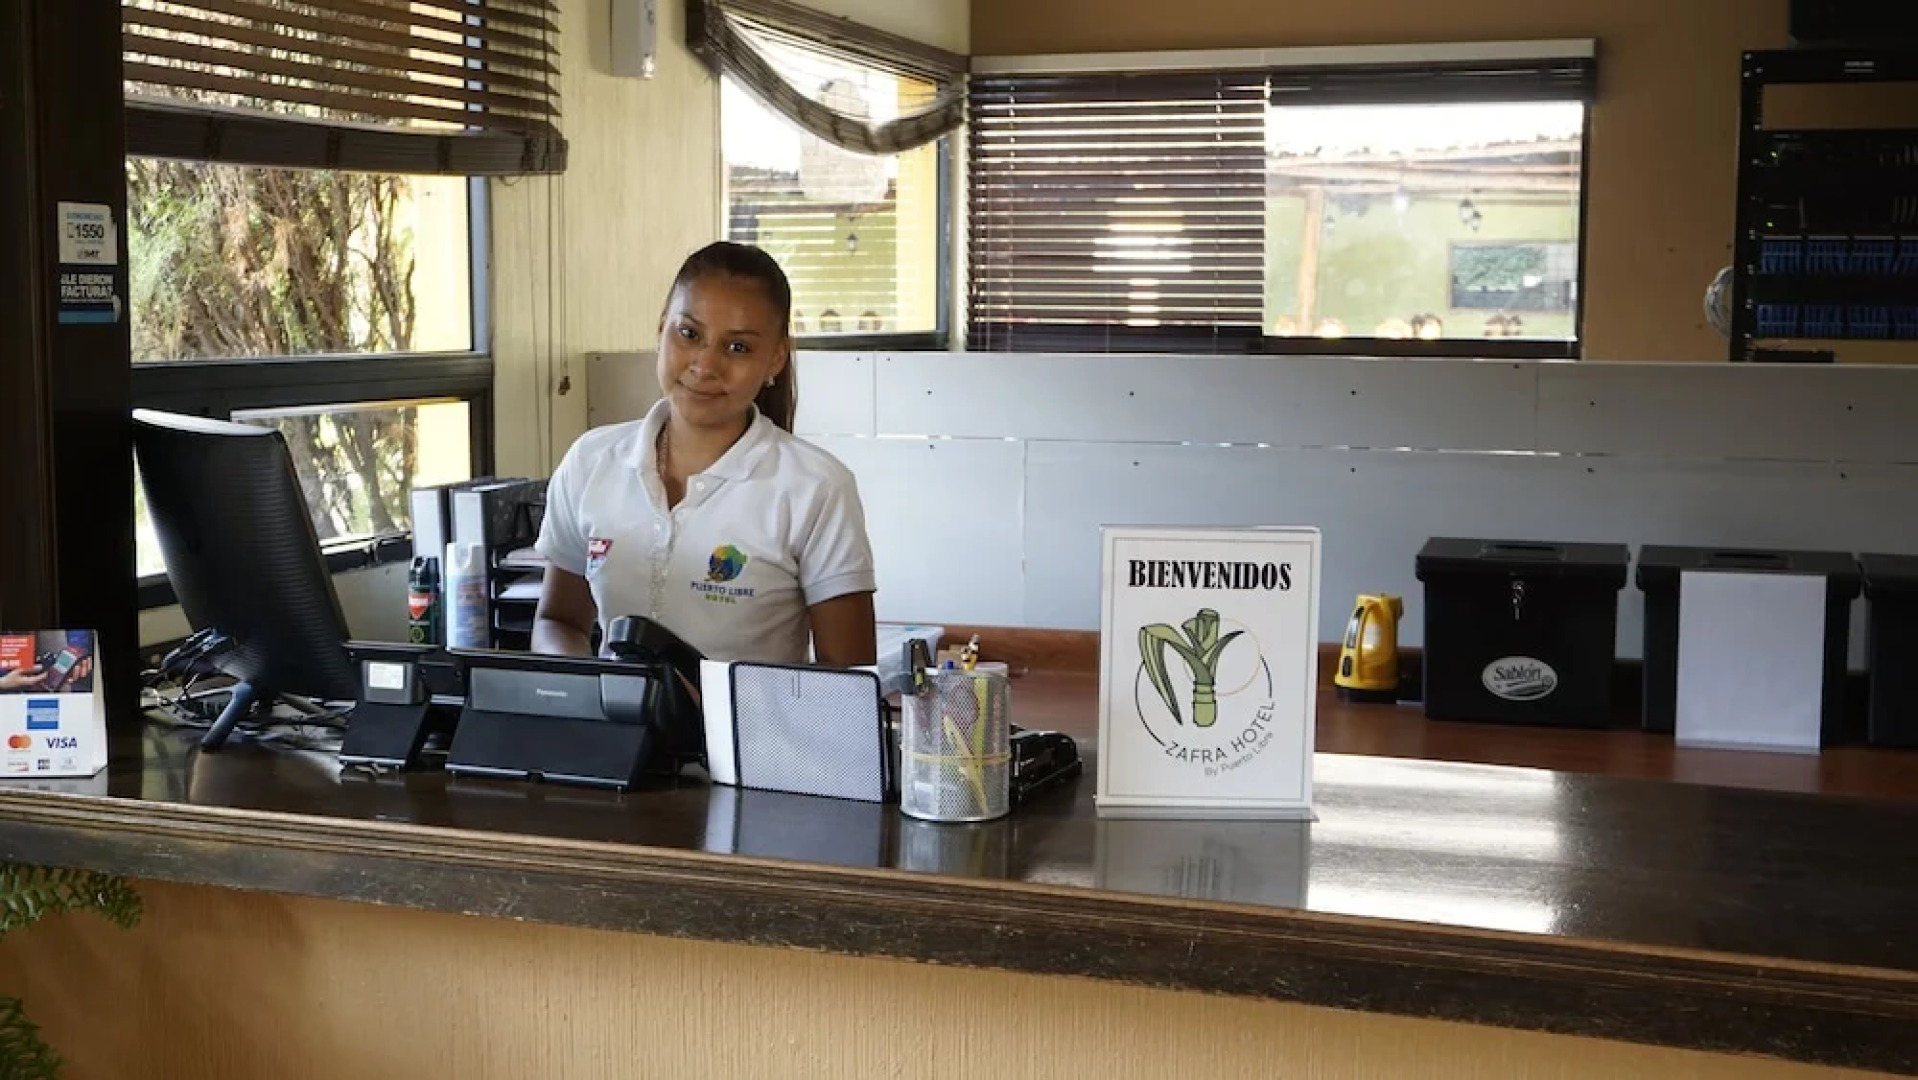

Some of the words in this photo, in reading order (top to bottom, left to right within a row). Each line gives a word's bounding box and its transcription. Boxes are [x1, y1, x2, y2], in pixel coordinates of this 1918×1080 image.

[76, 223, 105, 239] 1550
[1128, 559, 1292, 591] BIENVENIDOS
[690, 581, 726, 594] PUERTO
[728, 587, 754, 596] LIBRE
[46, 737, 78, 749] VISA
[1165, 740, 1228, 763] ZAFRA
[1231, 700, 1276, 753] HOTEL
[1204, 766, 1219, 778] By
[1220, 752, 1254, 775] Puerto
[1253, 731, 1275, 756] Libre
